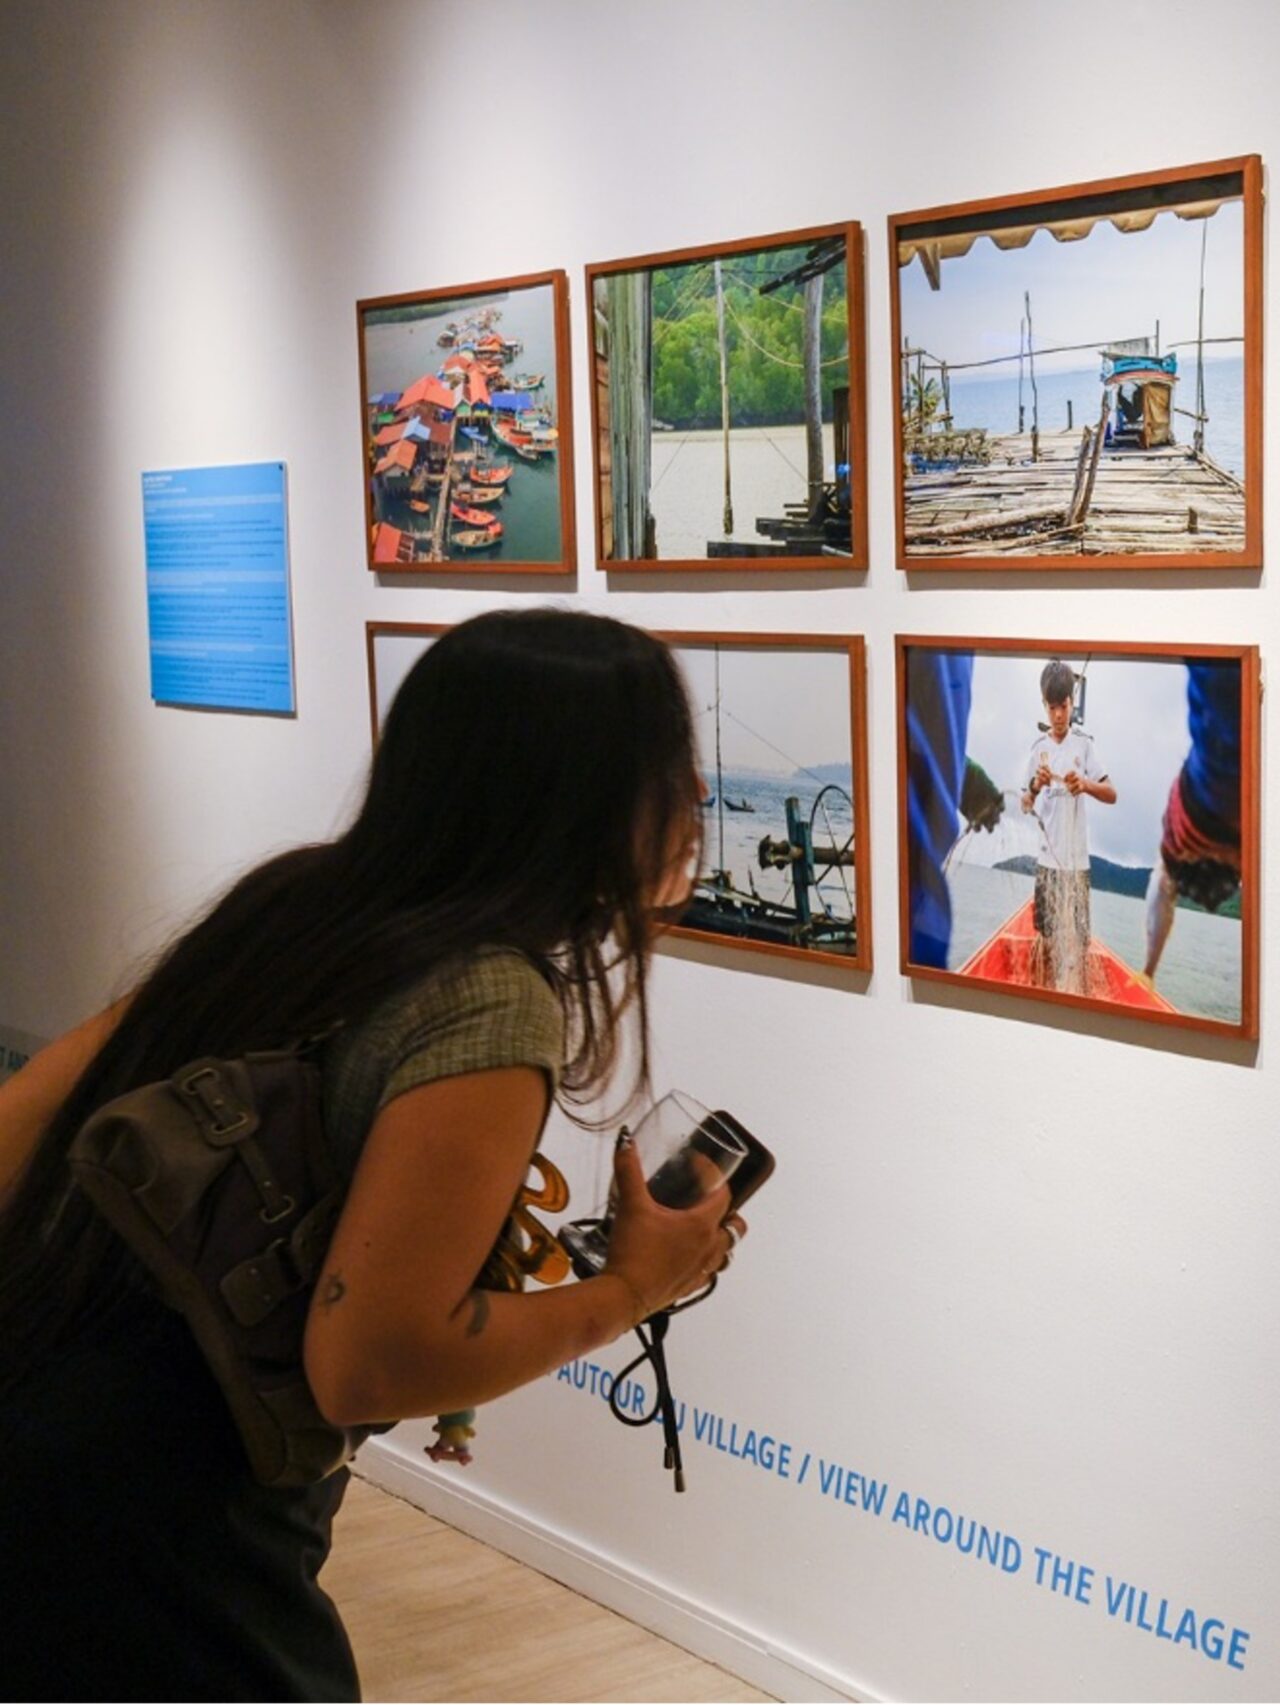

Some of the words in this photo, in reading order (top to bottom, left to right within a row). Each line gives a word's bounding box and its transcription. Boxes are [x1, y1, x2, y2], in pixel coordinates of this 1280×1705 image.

[694, 1408, 791, 1478] VILLAGE
[797, 1453, 811, 1484] /
[819, 1459, 888, 1516] VIEW
[891, 1491, 1022, 1574] AROUND
[1034, 1547, 1095, 1605] THE
[1105, 1576, 1250, 1671] VILLAGE
